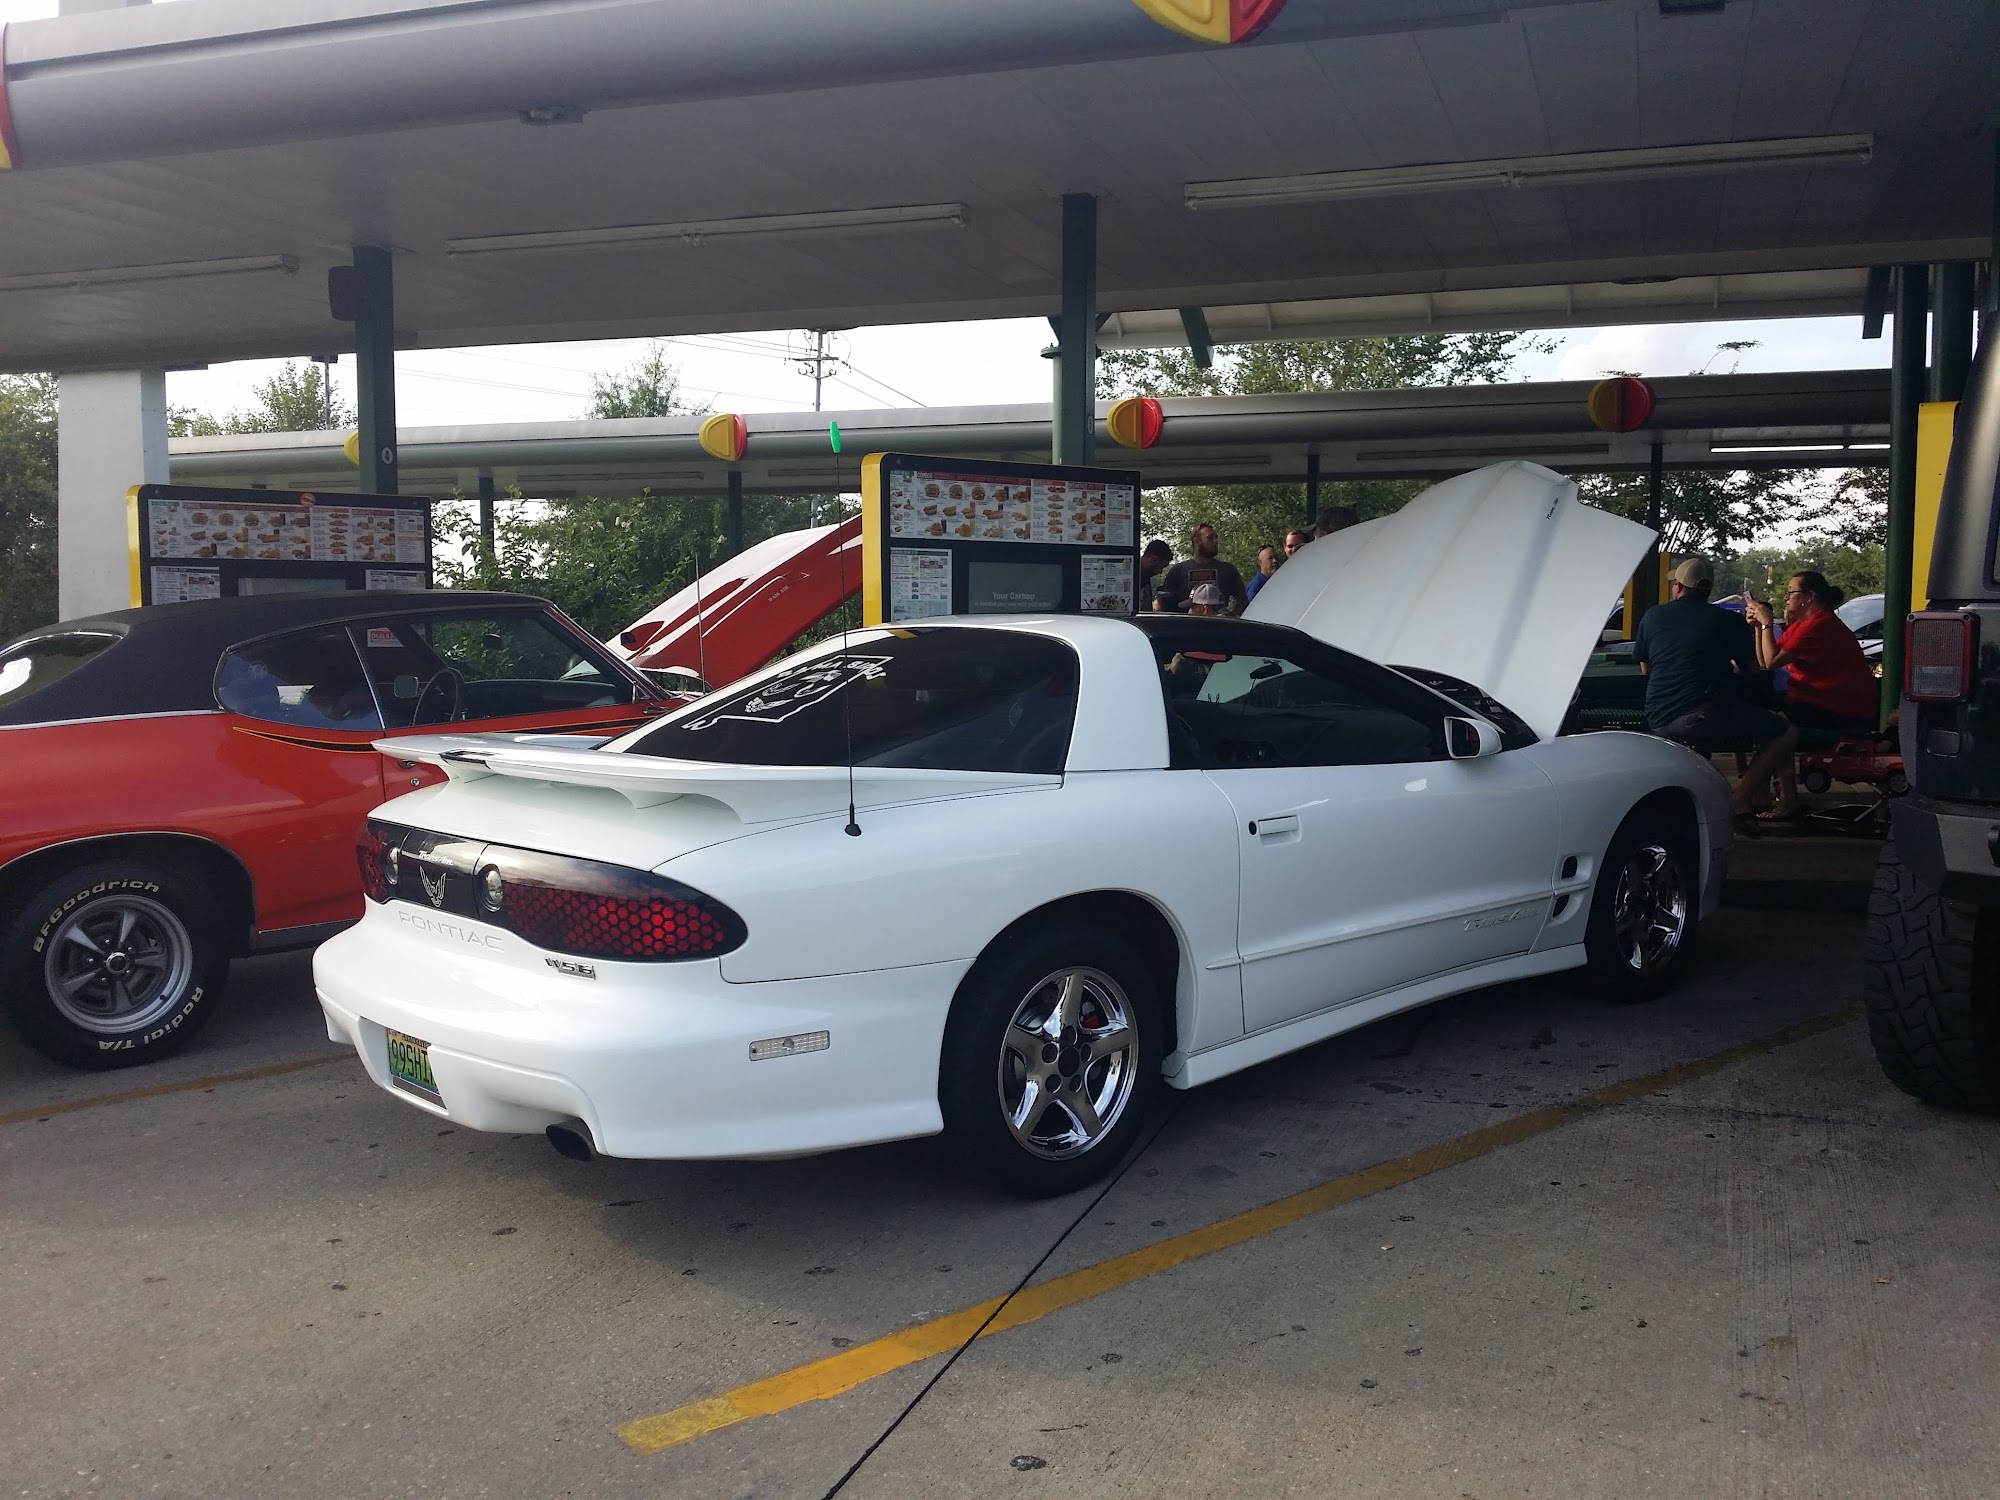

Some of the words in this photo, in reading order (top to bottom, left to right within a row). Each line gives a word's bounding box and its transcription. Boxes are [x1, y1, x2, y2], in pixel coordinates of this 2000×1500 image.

[992, 591, 1009, 600] Your
[1010, 591, 1035, 601] Carhop
[33, 879, 160, 953] BFGoodrich
[398, 910, 505, 952] PONTIAC
[143, 986, 204, 1045] Radial
[98, 1039, 136, 1051] T/A
